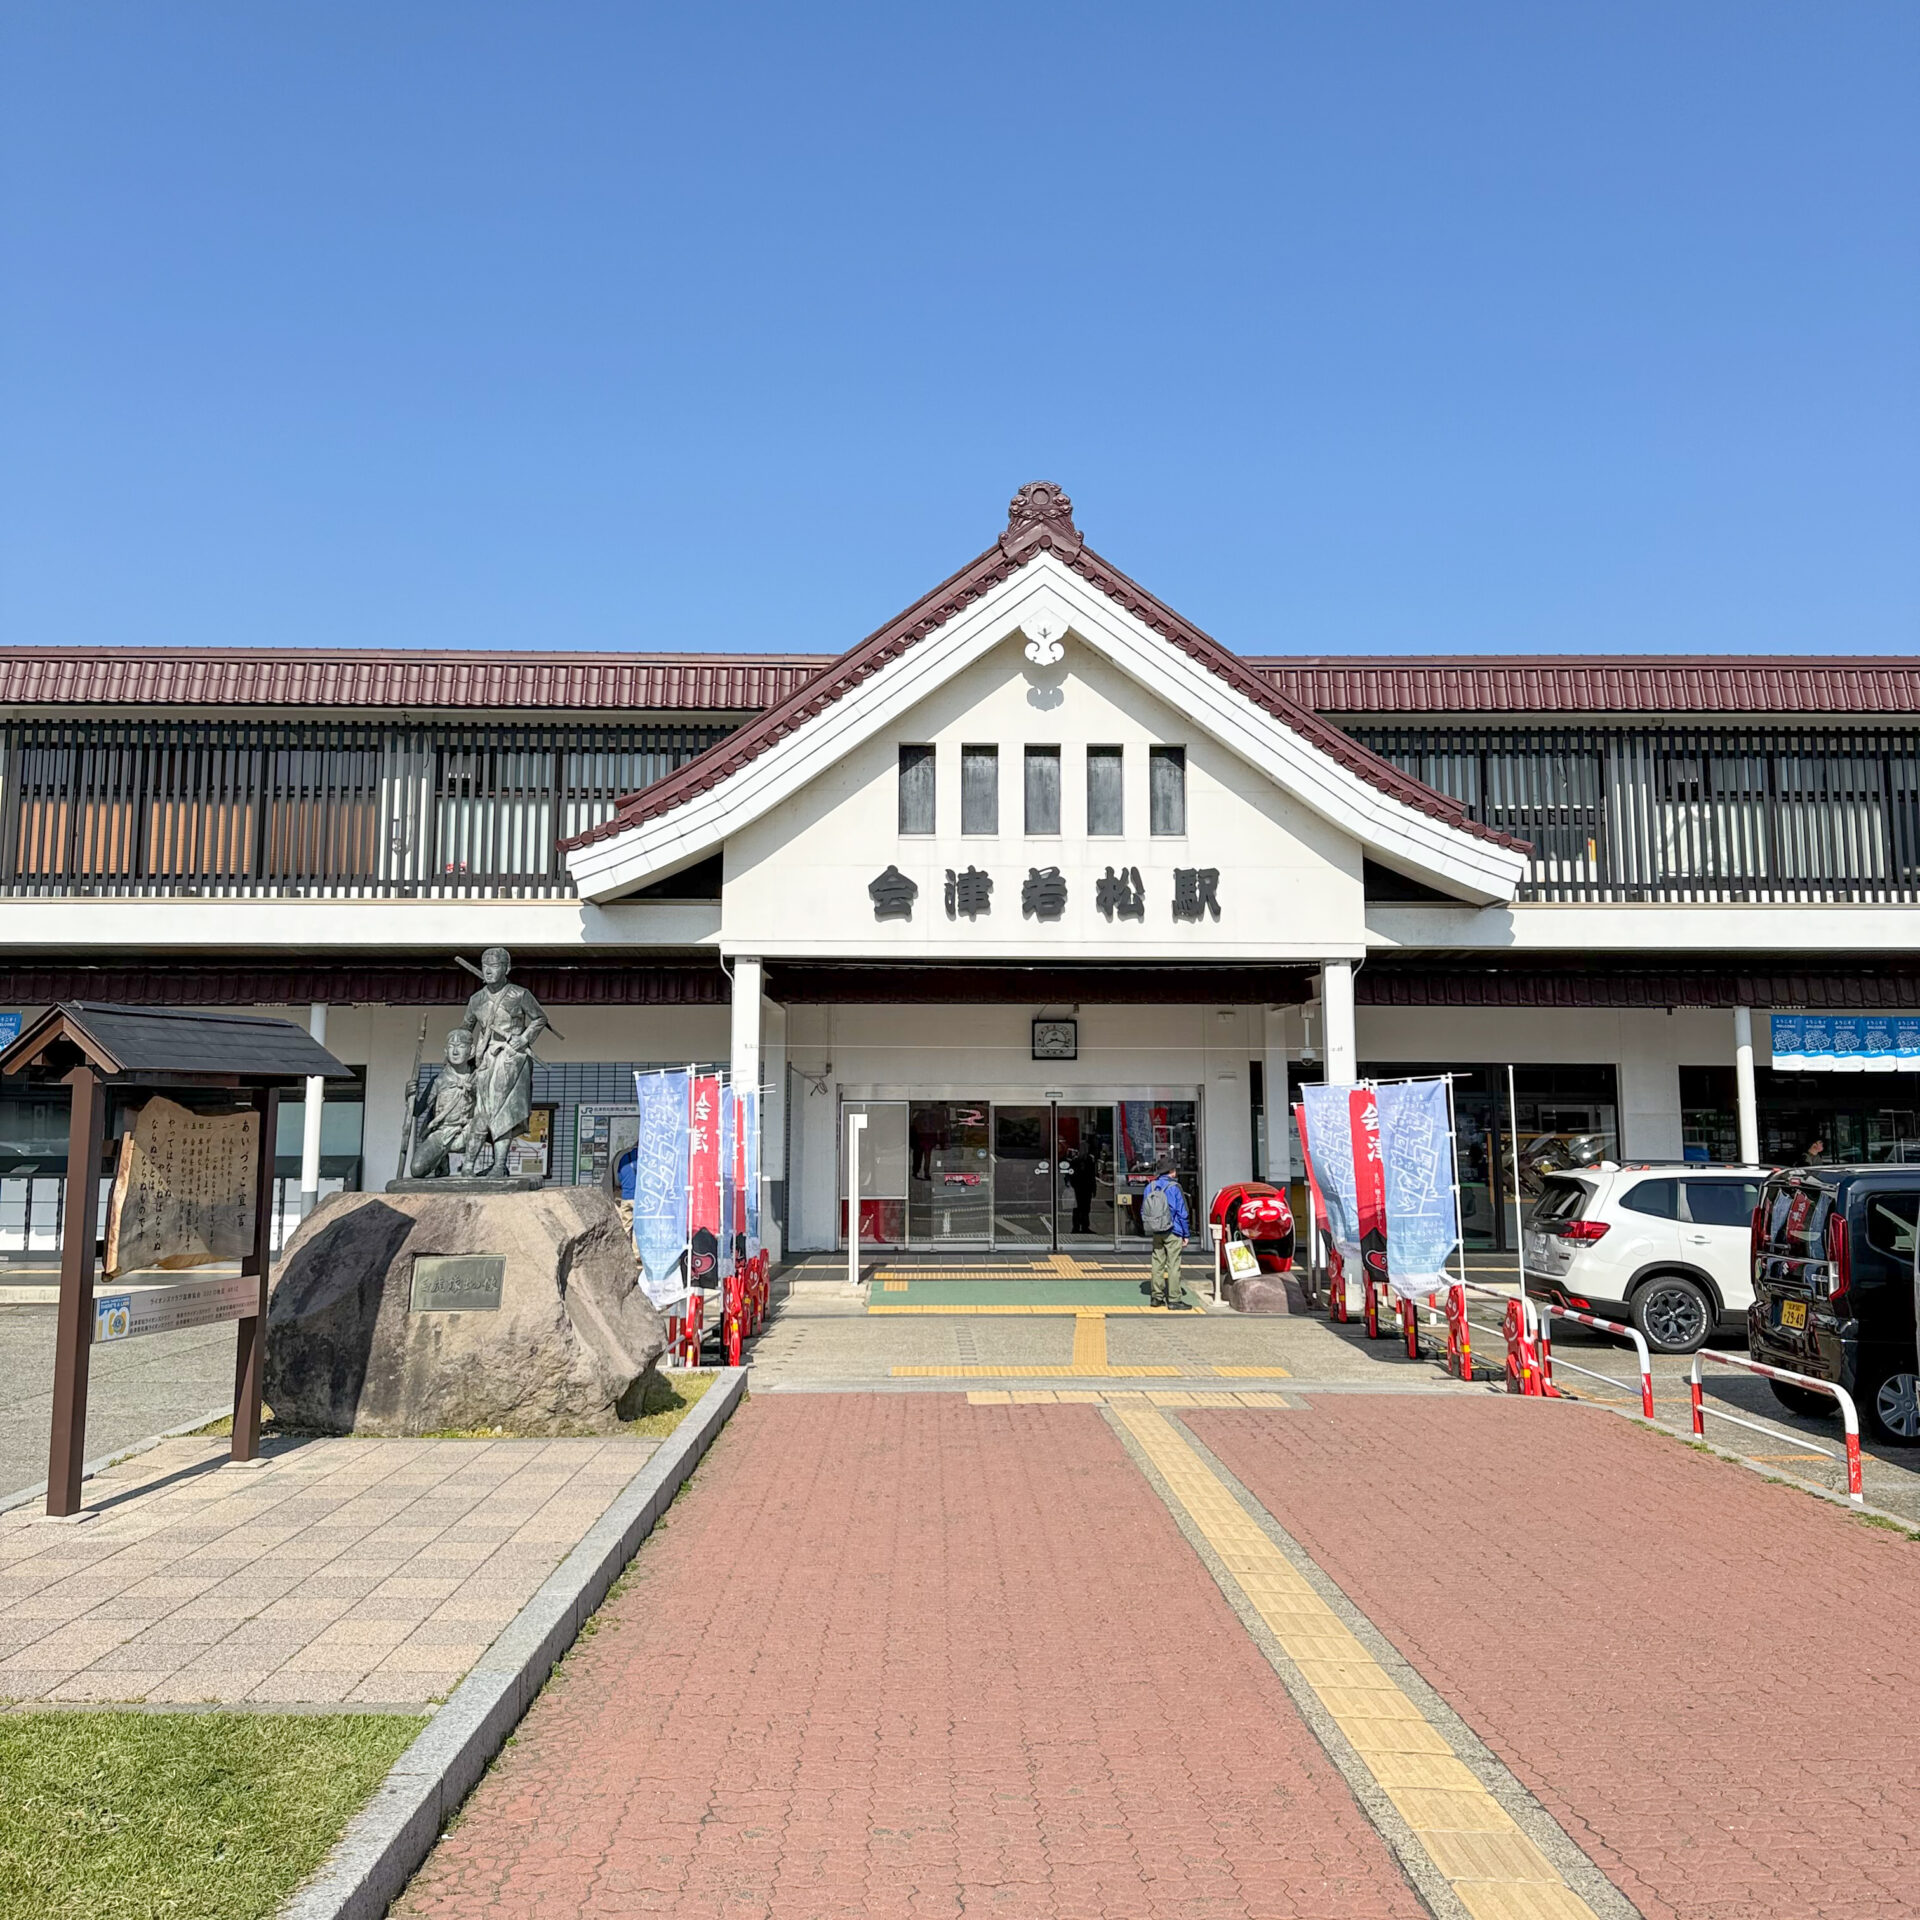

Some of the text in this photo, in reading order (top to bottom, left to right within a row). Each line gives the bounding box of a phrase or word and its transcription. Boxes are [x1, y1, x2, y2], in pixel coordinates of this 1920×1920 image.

[868, 865, 1221, 922] 会津若松駅
